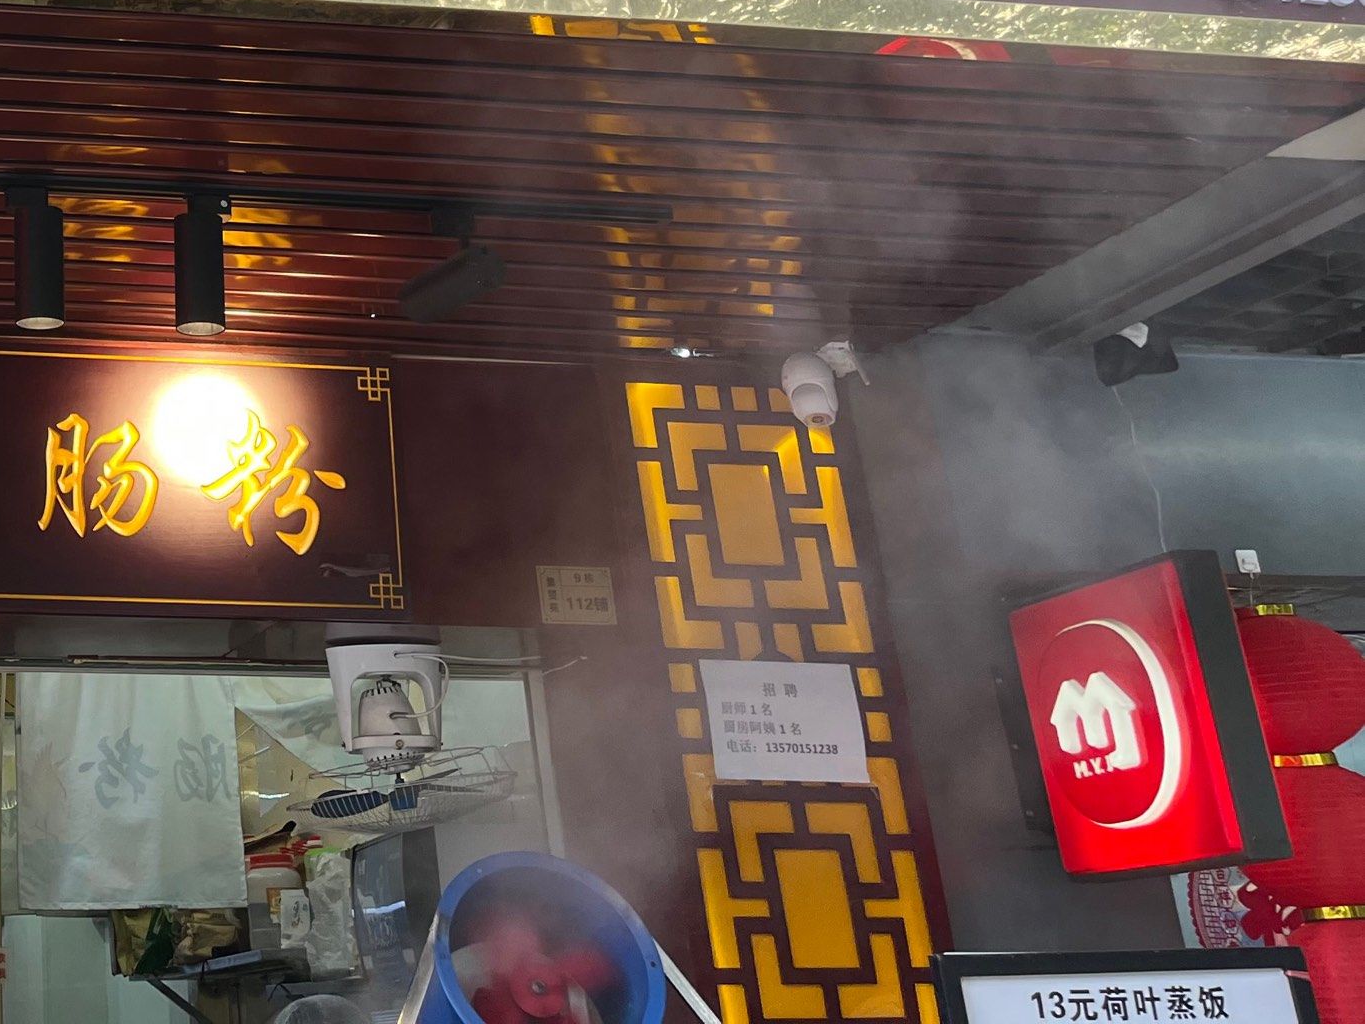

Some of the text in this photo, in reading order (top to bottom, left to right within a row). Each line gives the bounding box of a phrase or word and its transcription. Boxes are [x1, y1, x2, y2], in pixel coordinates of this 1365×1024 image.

[1031, 986, 1230, 1022] 13元荷叶蒸饭
